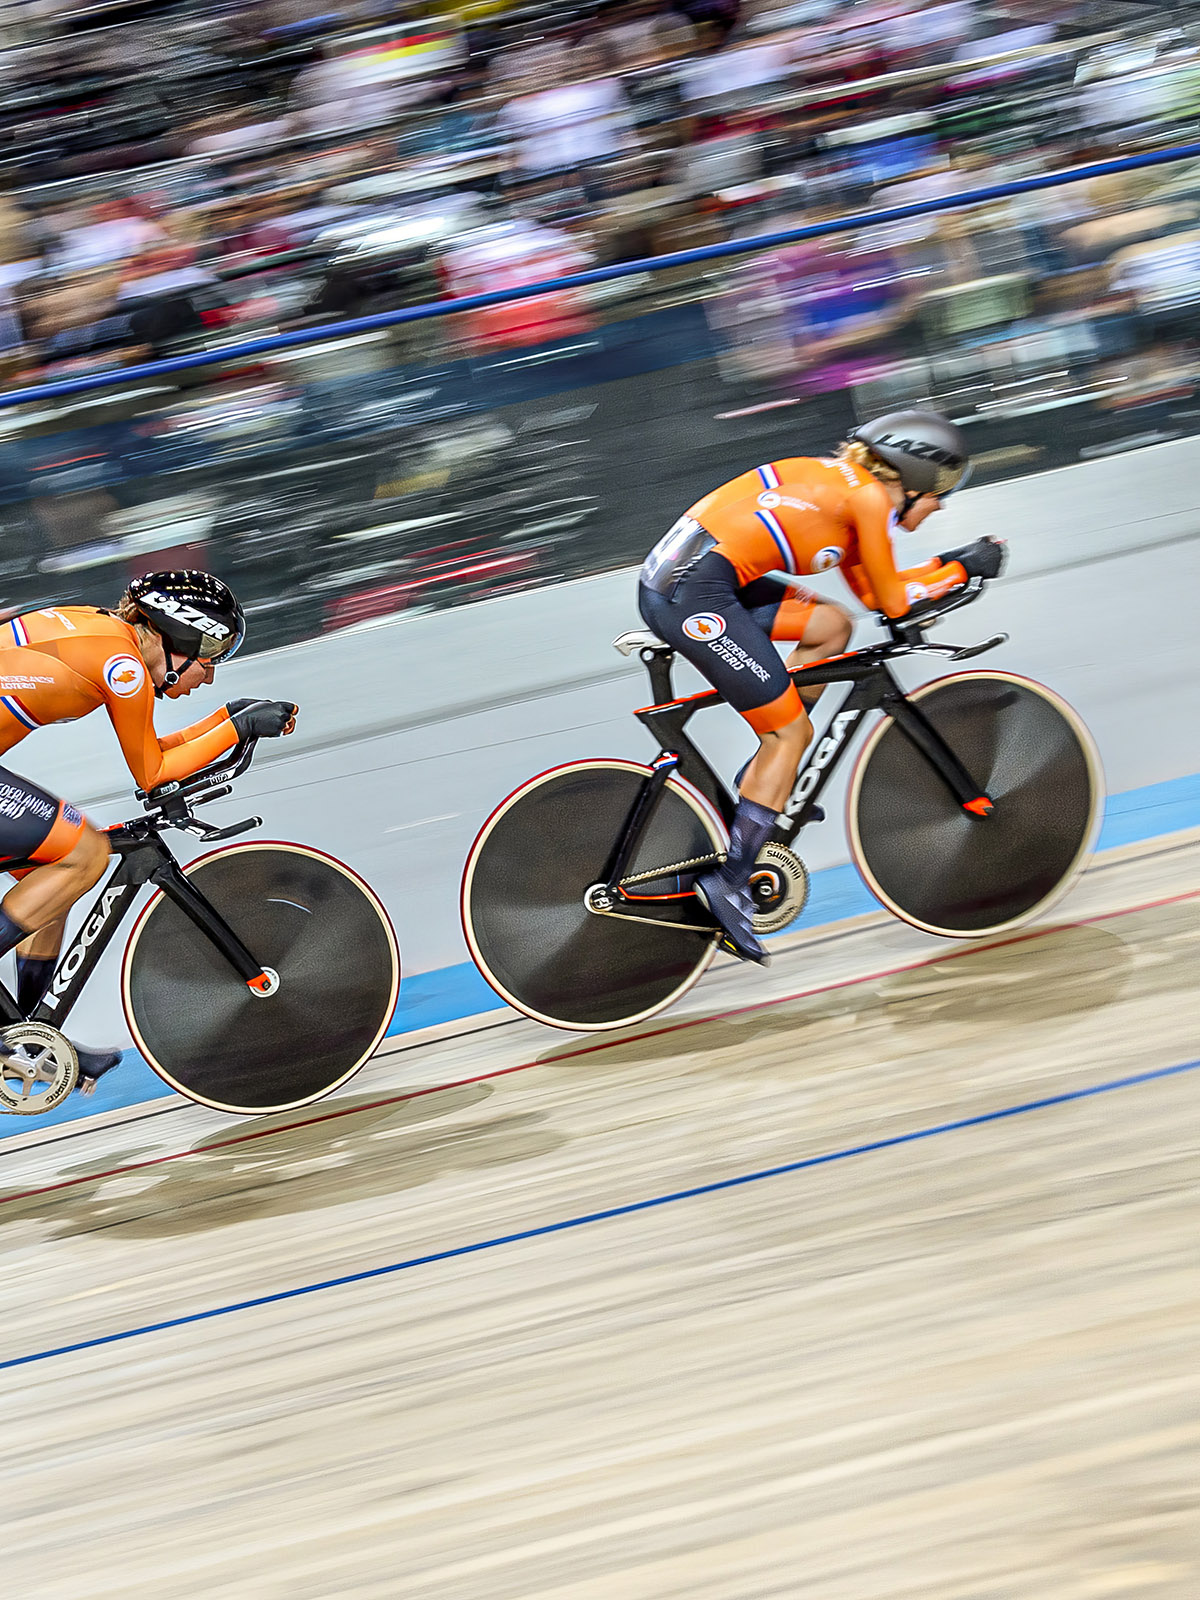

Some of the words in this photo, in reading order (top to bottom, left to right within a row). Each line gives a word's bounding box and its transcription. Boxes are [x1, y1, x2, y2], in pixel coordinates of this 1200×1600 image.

[139, 590, 231, 641] LAZER
[707, 640, 746, 671] LOTERIJ
[718, 635, 771, 683] NEDERLANDSE
[773, 708, 861, 832] KOGA
[41, 884, 128, 1011] KOGA
